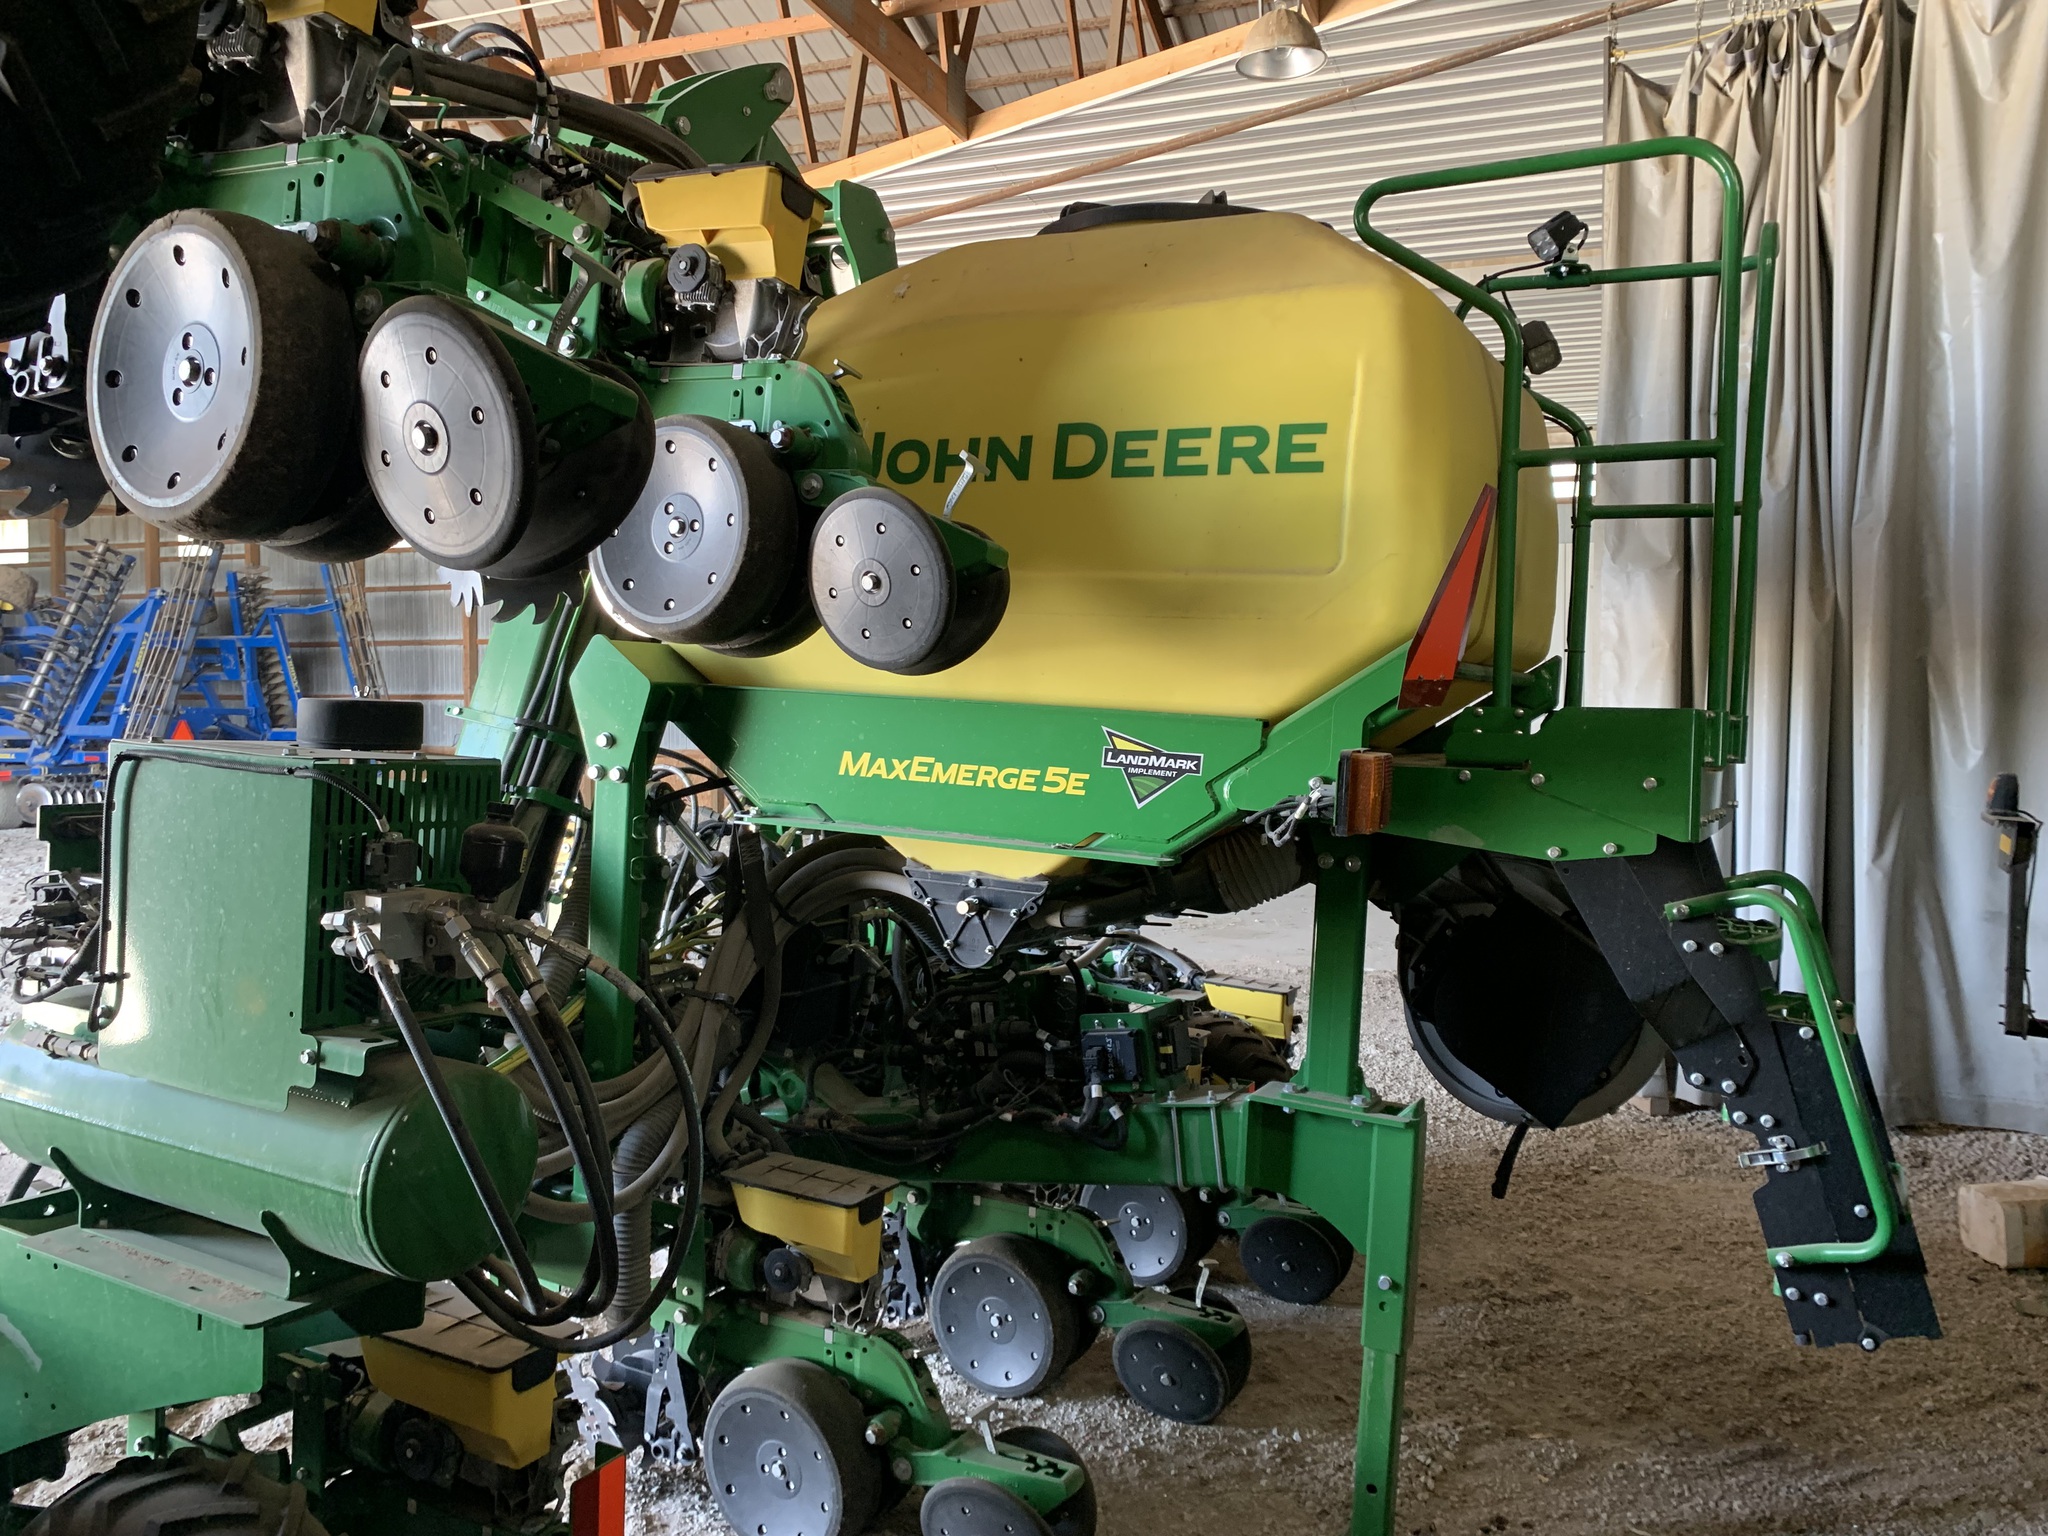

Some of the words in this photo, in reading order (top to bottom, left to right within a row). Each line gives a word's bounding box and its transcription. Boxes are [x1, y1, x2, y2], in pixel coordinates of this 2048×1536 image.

[1052, 422, 1328, 480] DEERE
[1041, 767, 1091, 797] 5E
[1127, 767, 1178, 778] IMPLEMENT
